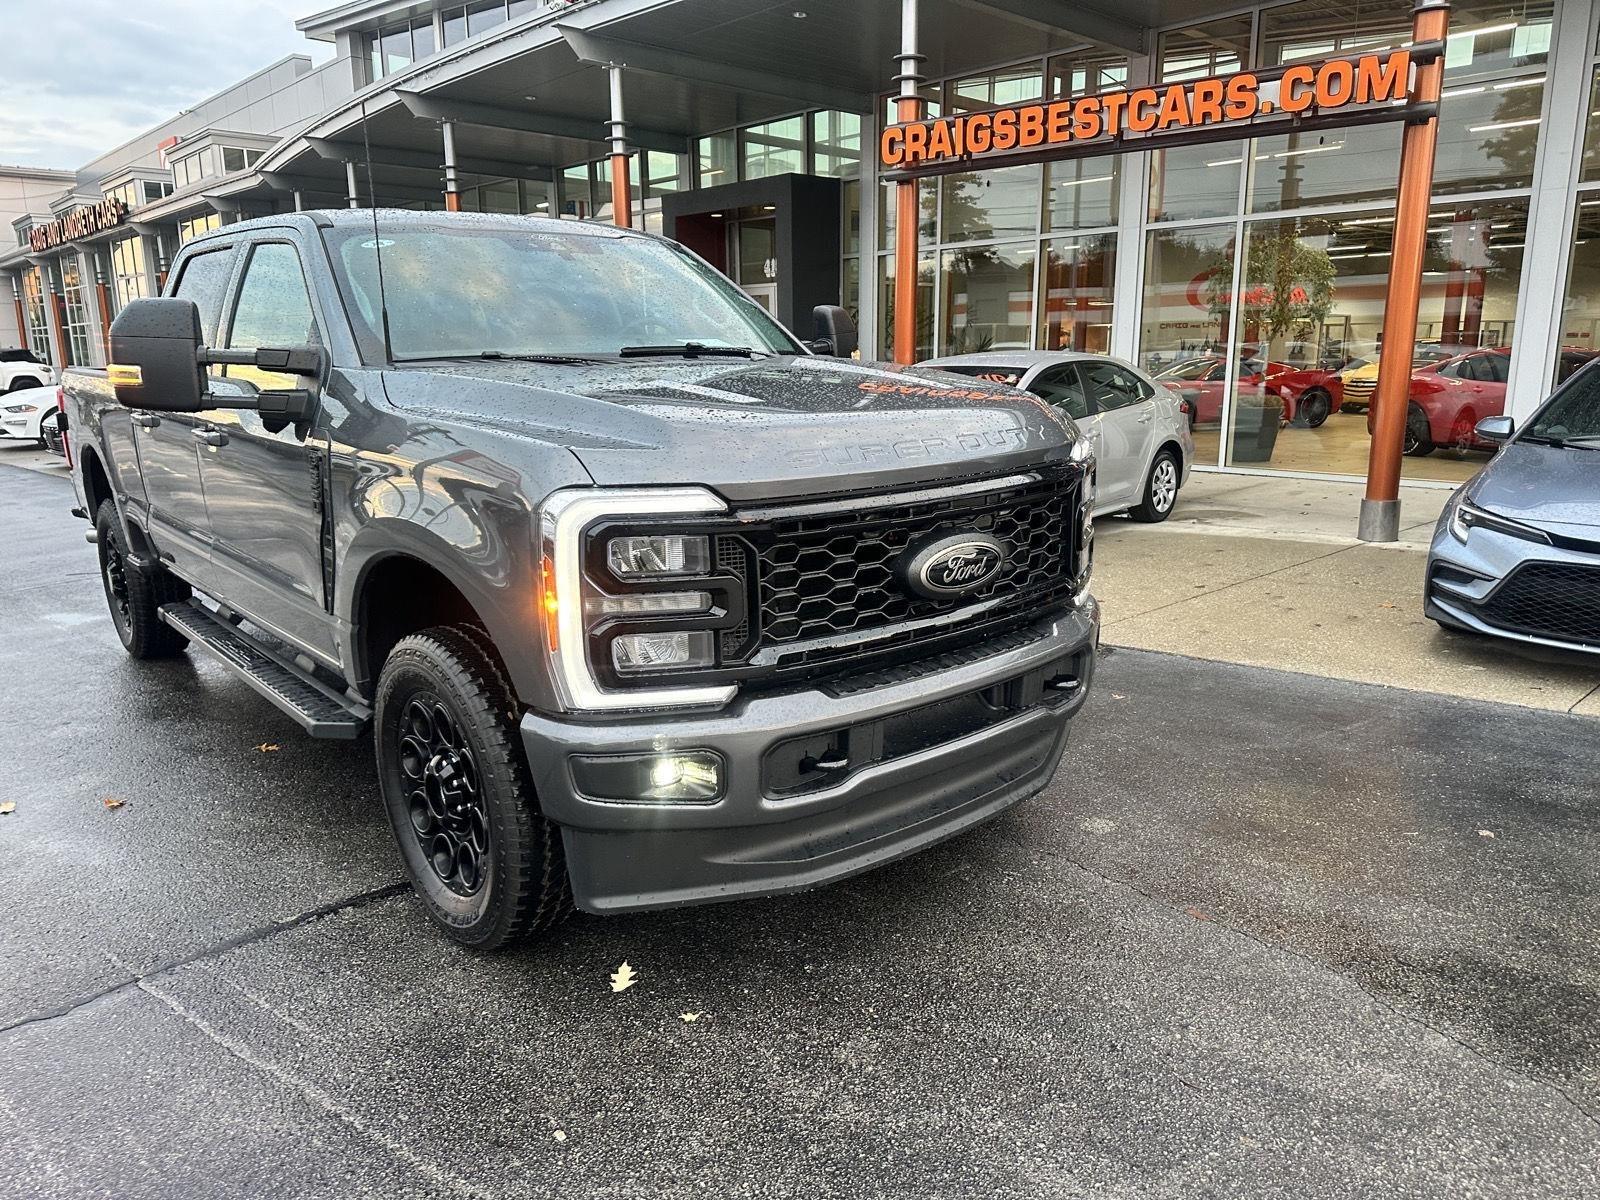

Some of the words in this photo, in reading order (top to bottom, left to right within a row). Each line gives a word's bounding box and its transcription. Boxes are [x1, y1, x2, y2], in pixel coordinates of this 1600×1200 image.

[881, 51, 1411, 165] CRAIGSBESTCARS.COM
[47, 220, 60, 246] AND
[96, 197, 118, 230] CARS
[786, 437, 949, 469] SUPER
[957, 424, 1045, 451] DUTY
[942, 552, 987, 583] Ford
